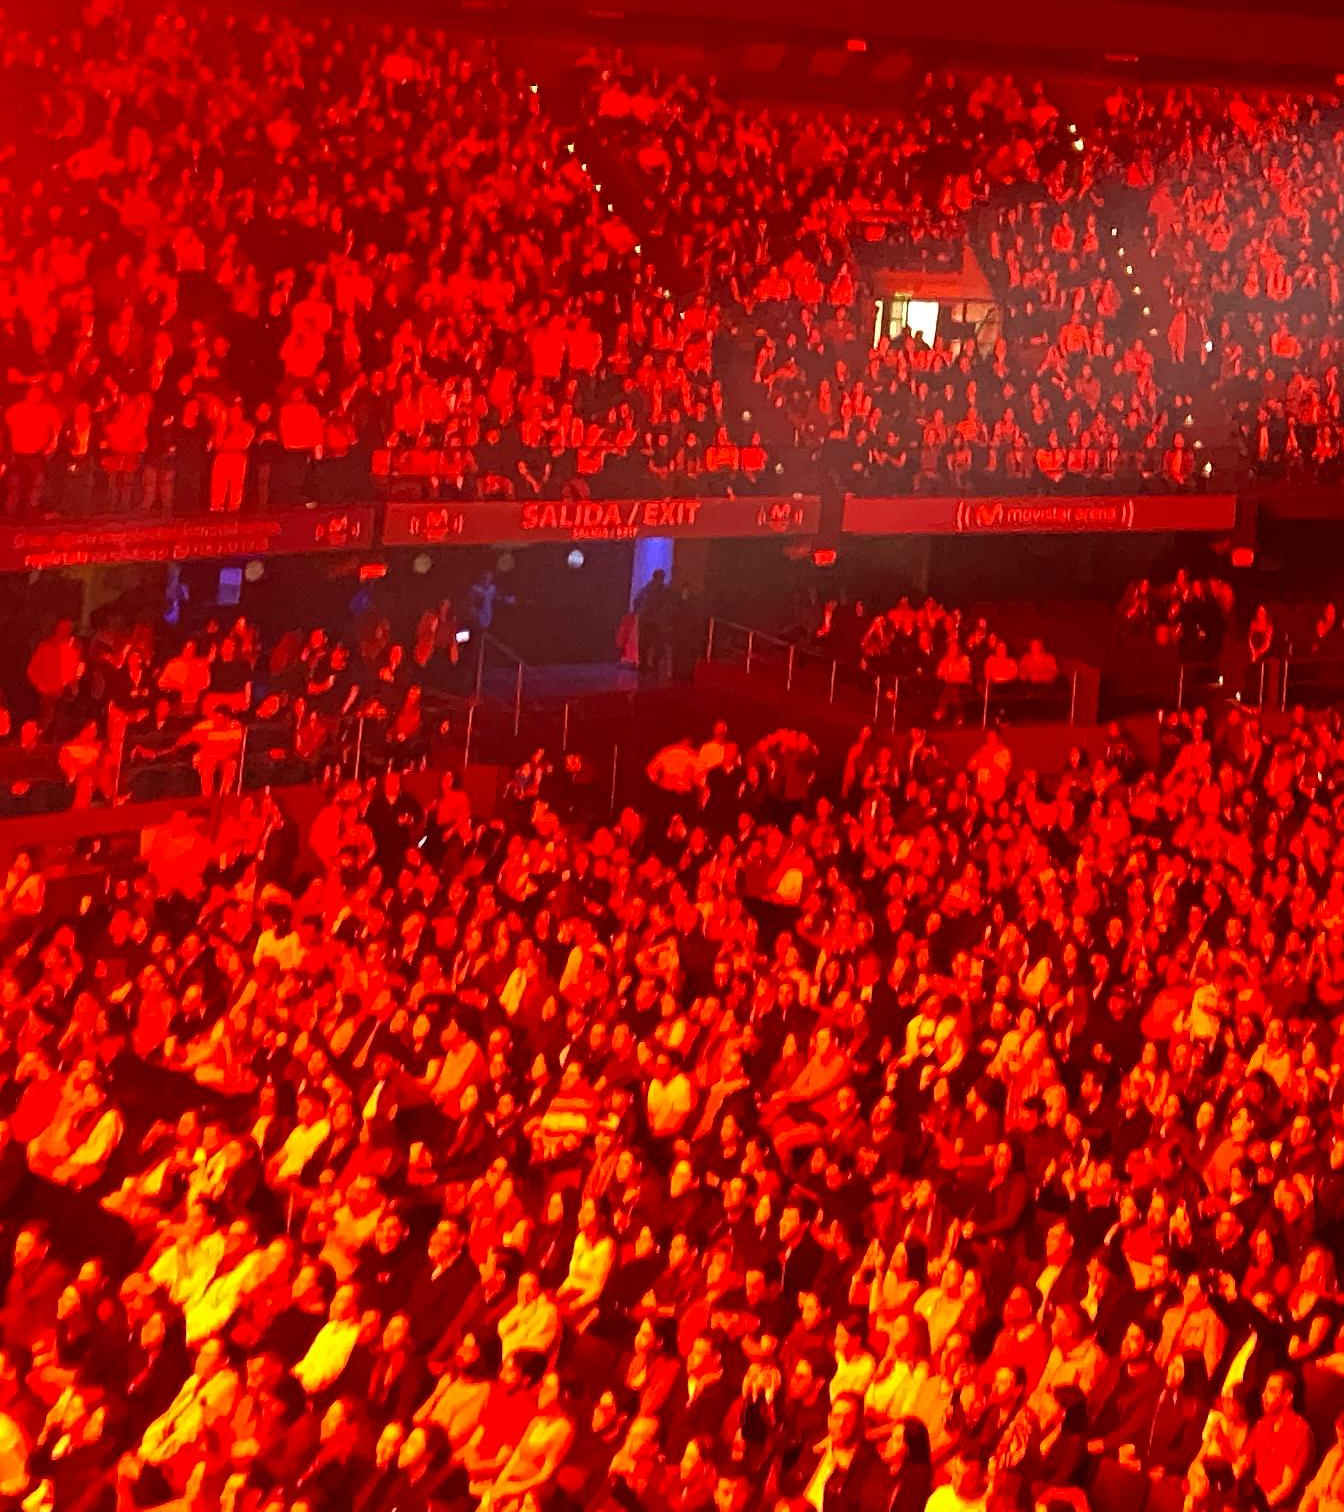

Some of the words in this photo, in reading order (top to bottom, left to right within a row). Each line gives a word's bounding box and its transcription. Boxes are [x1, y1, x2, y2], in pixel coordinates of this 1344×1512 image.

[521, 503, 622, 530] SALIDA
[643, 502, 702, 528] EXIT
[1007, 506, 1071, 523] movistar
[1074, 507, 1115, 522] arena
